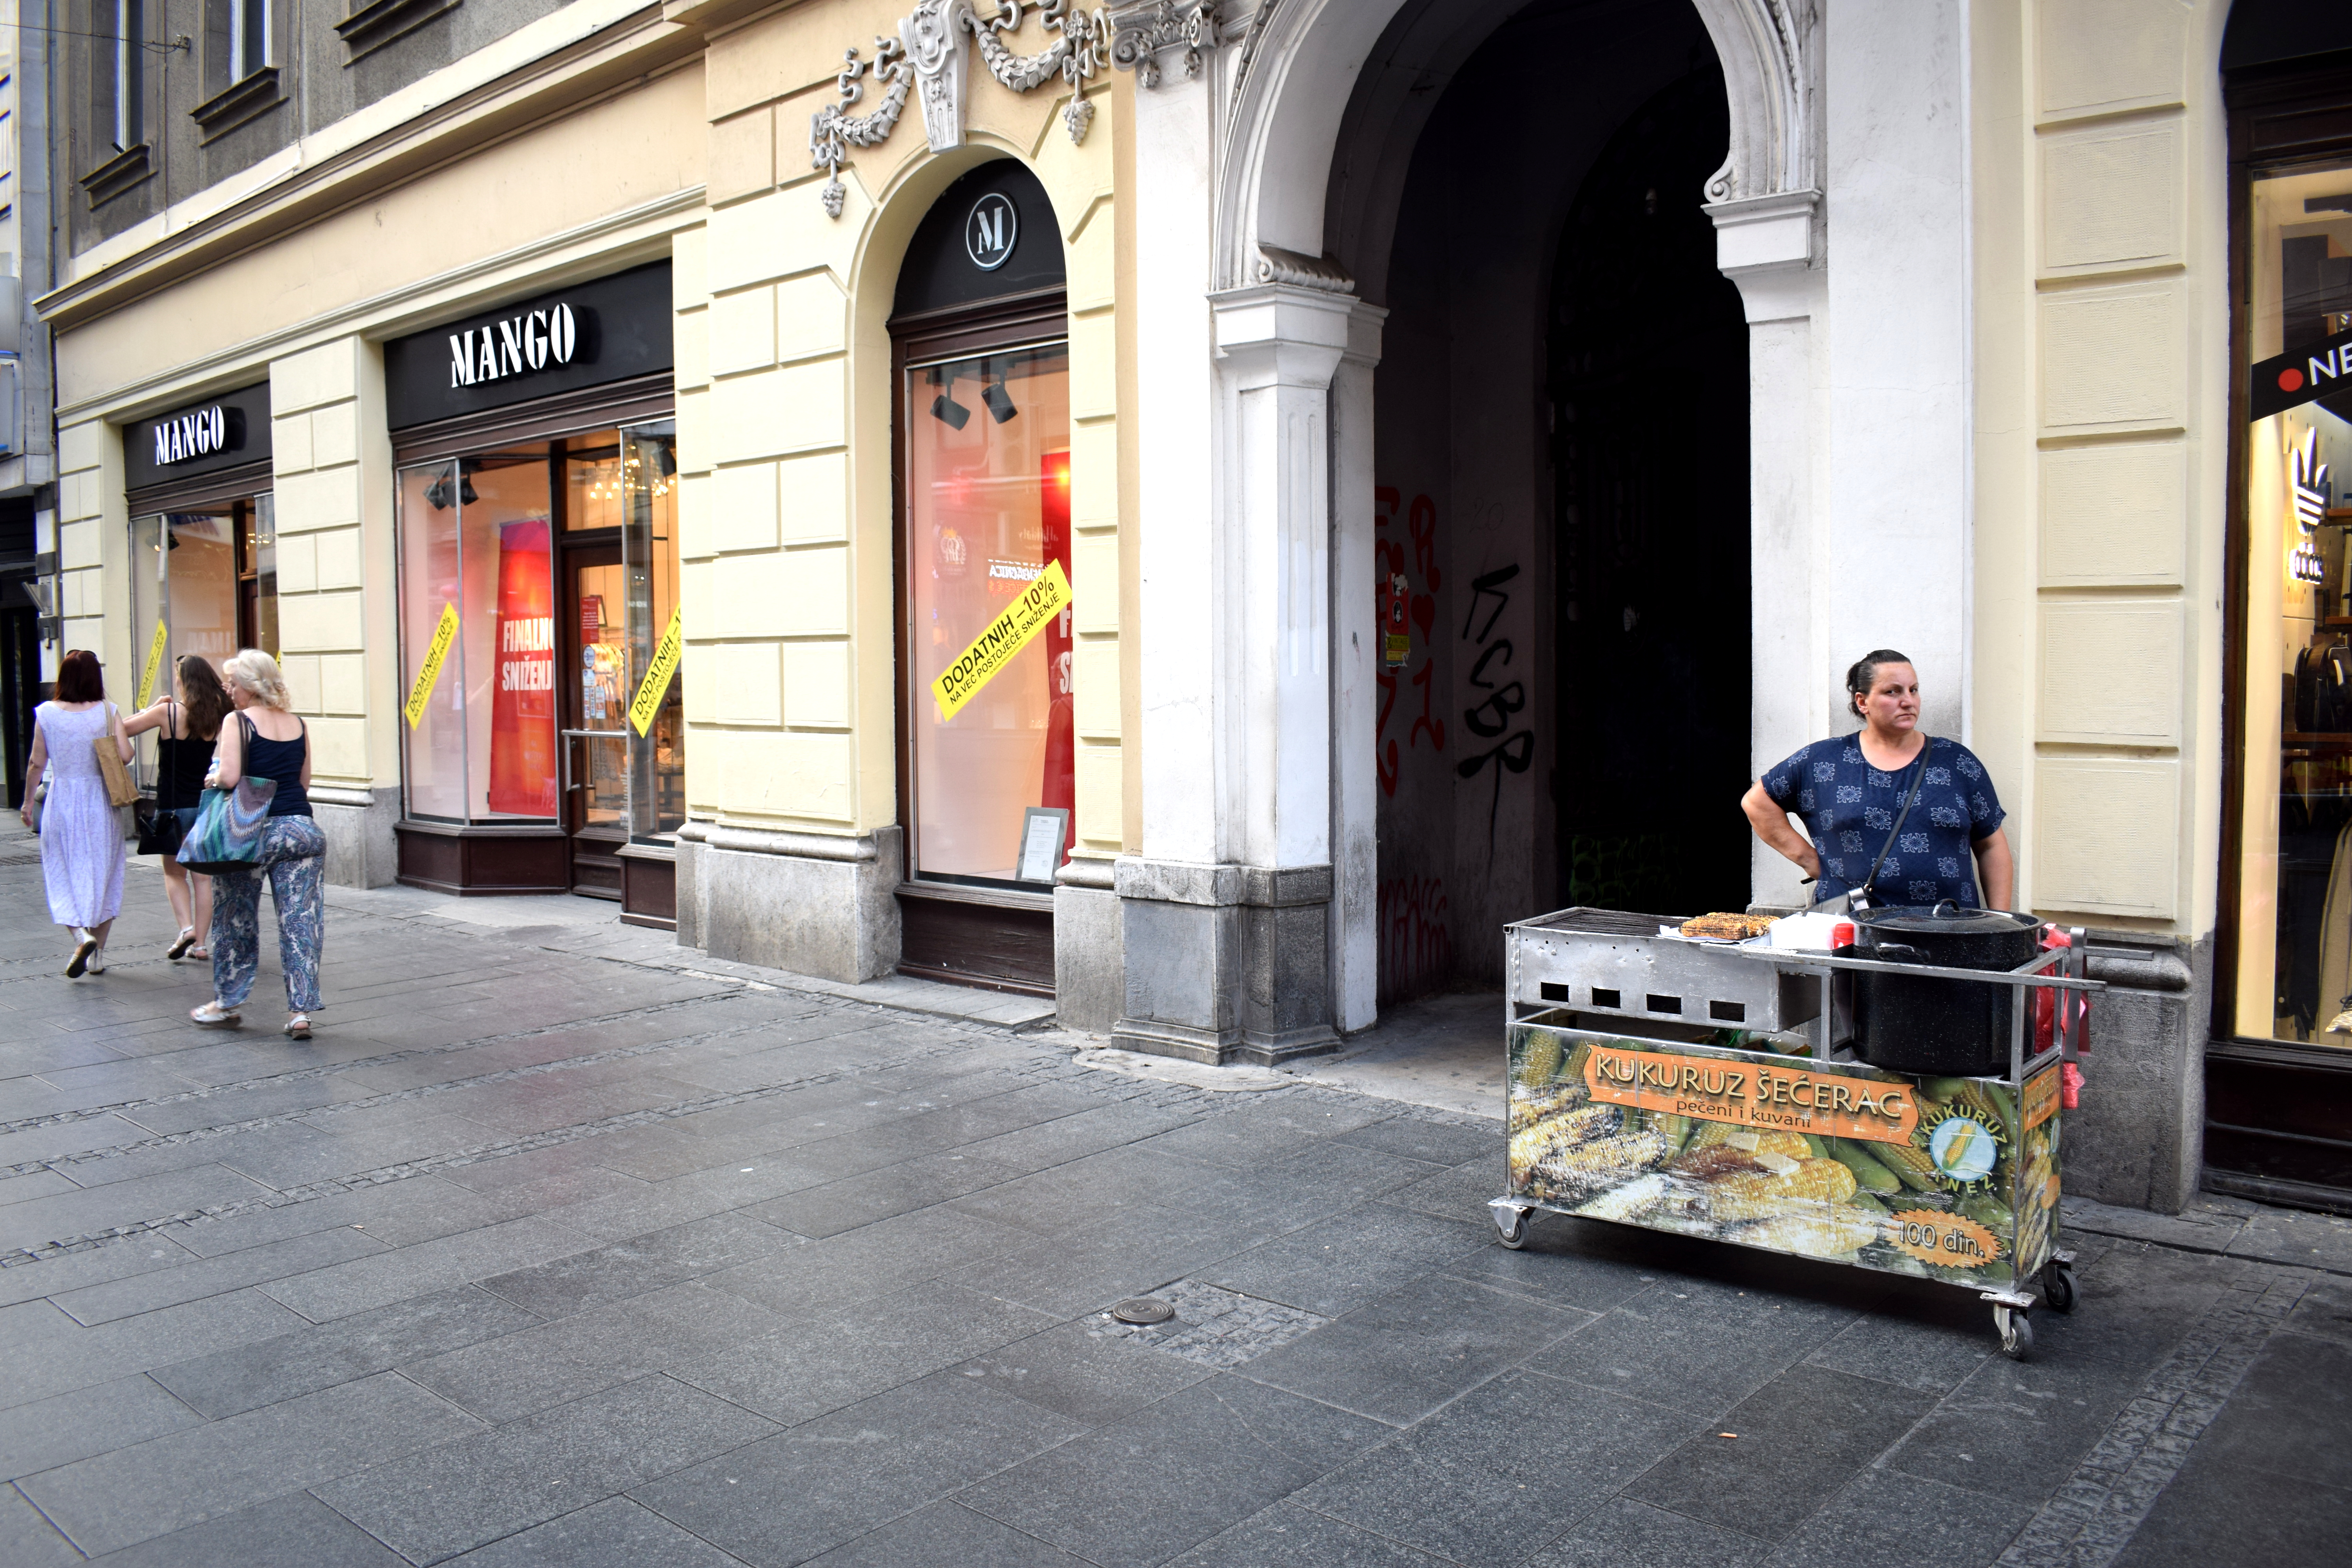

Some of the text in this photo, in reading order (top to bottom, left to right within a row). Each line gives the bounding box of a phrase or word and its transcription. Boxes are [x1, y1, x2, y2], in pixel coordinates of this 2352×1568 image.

[977, 206, 1004, 254] M
[450, 303, 575, 388] MANGO
[155, 405, 225, 466] MANGO
[409, 647, 437, 712] DODATNIH
[635, 635, 673, 715] DODATNIH
[942, 614, 1014, 694] DODATNIH
[949, 592, 1060, 705] NA VEĆ POSTOJEĆE SNIŽENJE
[642, 710, 649, 722] NA
[1596, 1054, 1901, 1118] KUKURUZ ŠEĆERAC
[1677, 1100, 1811, 1128] pečeni i kuvani
[1920, 1104, 2007, 1146] KUKURUZ
[1899, 1220, 1985, 1258] 100 din.
